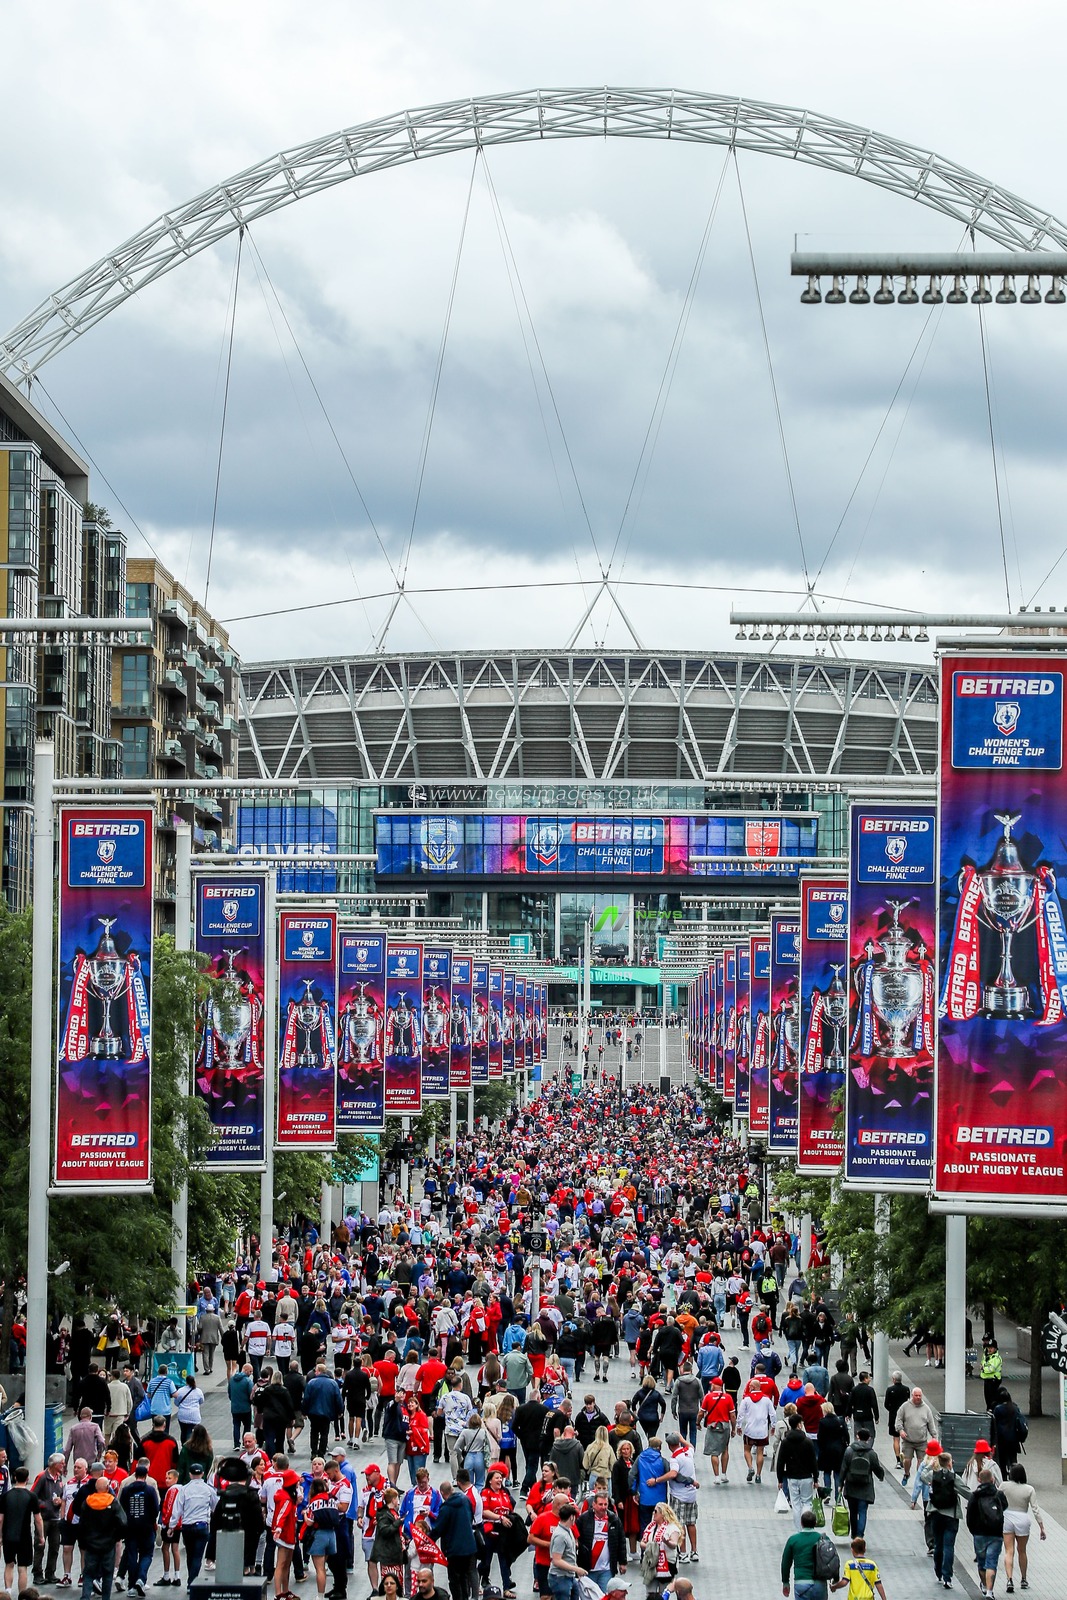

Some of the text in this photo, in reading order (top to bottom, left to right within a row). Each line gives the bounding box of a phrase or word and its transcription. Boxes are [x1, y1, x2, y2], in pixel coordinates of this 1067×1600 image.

[960, 678, 1055, 695] BETFRED
[984, 738, 1030, 747] WOMEN'S
[968, 747, 1045, 756] CHALLENGE CUP
[992, 756, 1020, 765] FINAL
[74, 824, 140, 836] BETFRED
[864, 820, 930, 832] BETFRED
[576, 825, 657, 840] BETFRED
[577, 847, 653, 857] CHALLENGE CUP
[601, 856, 629, 865] FINAL
[867, 865, 909, 873] CHALLENGE
[885, 872, 907, 880] FINAL
[206, 888, 256, 897] BETFRED
[288, 921, 329, 929] BETFRED
[1045, 901, 1067, 972] BETFRED
[594, 971, 633, 981] WEMBLEY
[864, 964, 873, 1005] BETFRED
[133, 977, 150, 1027] BETFRED
[862, 1012, 872, 1055] BETFRED
[286, 1113, 327, 1122] BETFRED
[71, 1134, 136, 1146] BETFRED
[861, 1131, 926, 1144] BETFRED
[956, 1126, 1050, 1145] BETFRED
[80, 1151, 126, 1159] PASSIONATE
[870, 1149, 917, 1157] PASSIONATE
[969, 1151, 1037, 1163] PASSIONATE
[61, 1160, 144, 1168] ABOUT RUGBY LEAGUE
[852, 1157, 877, 1165] ABOUT
[943, 1164, 1064, 1176] ABOUT RUGBY LEAGUE
